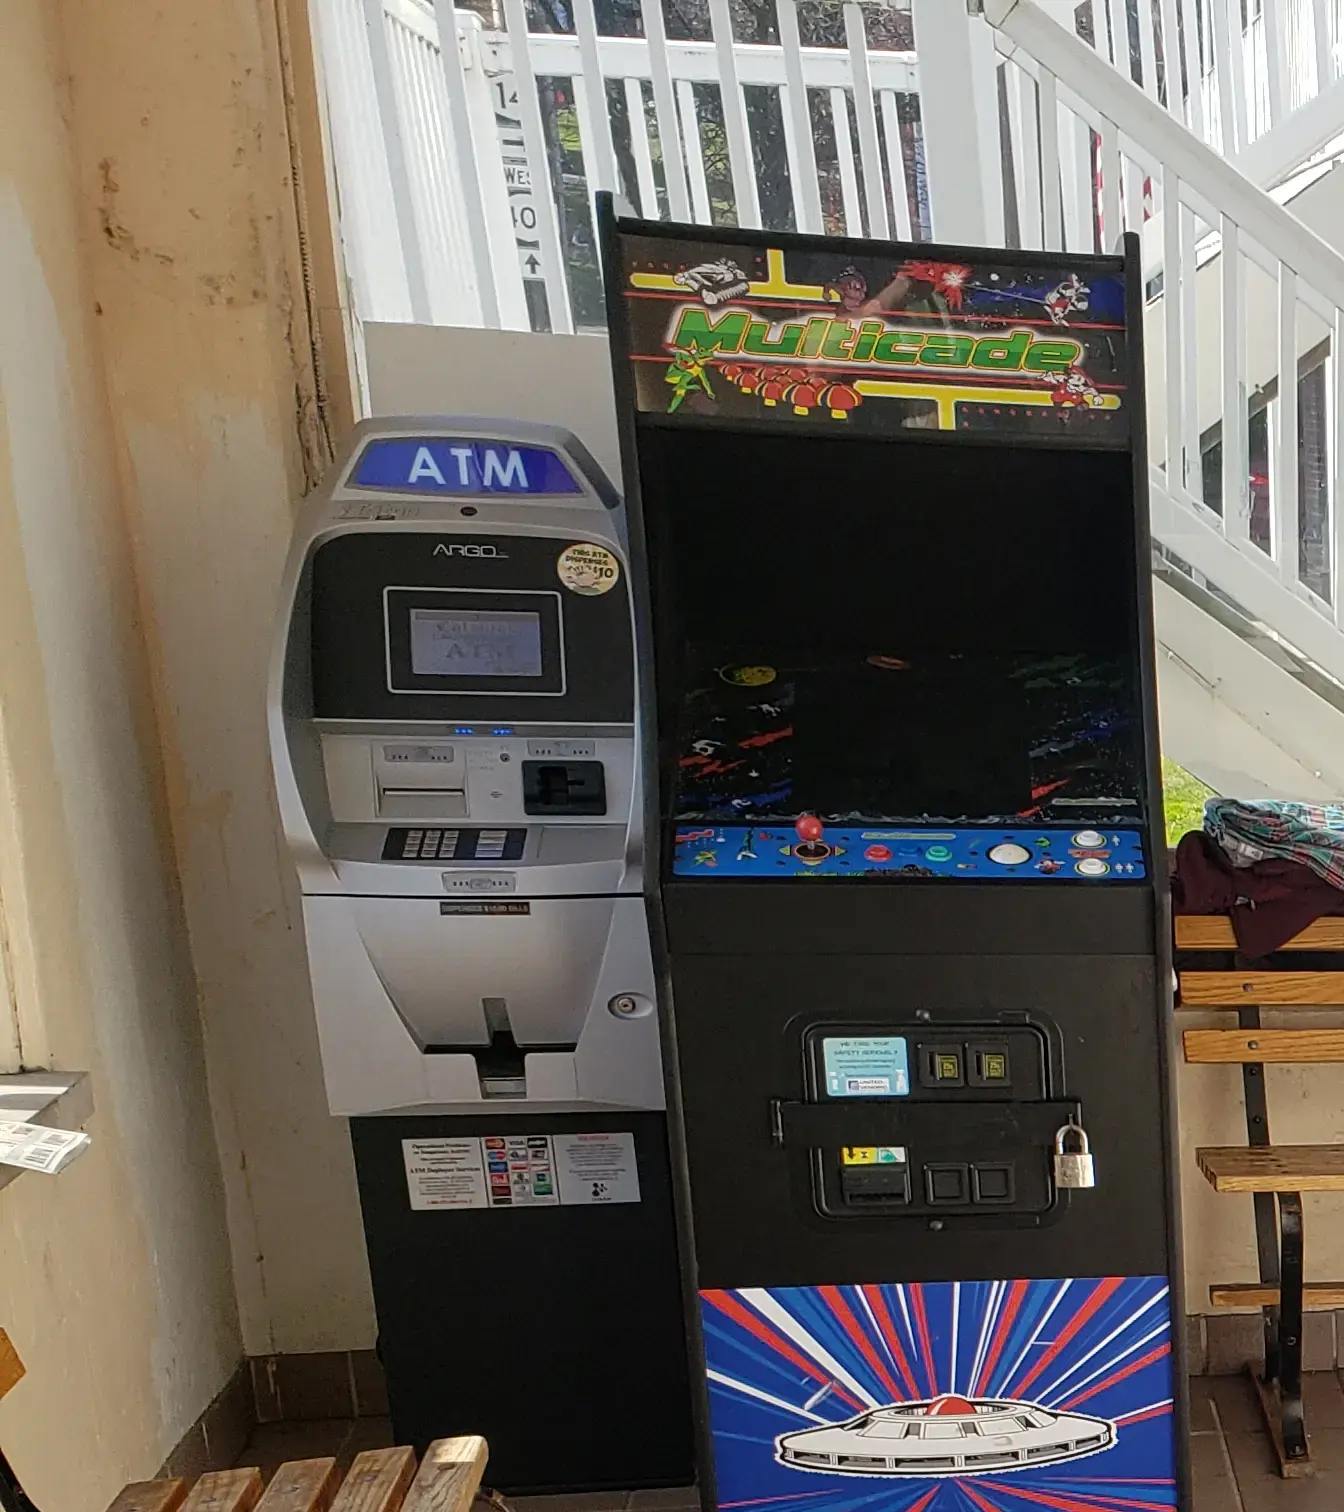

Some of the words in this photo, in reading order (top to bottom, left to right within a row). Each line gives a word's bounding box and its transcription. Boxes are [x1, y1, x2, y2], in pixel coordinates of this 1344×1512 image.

[673, 309, 1081, 375] Multicade
[407, 446, 529, 487] ATM
[432, 543, 504, 559] ARGO
